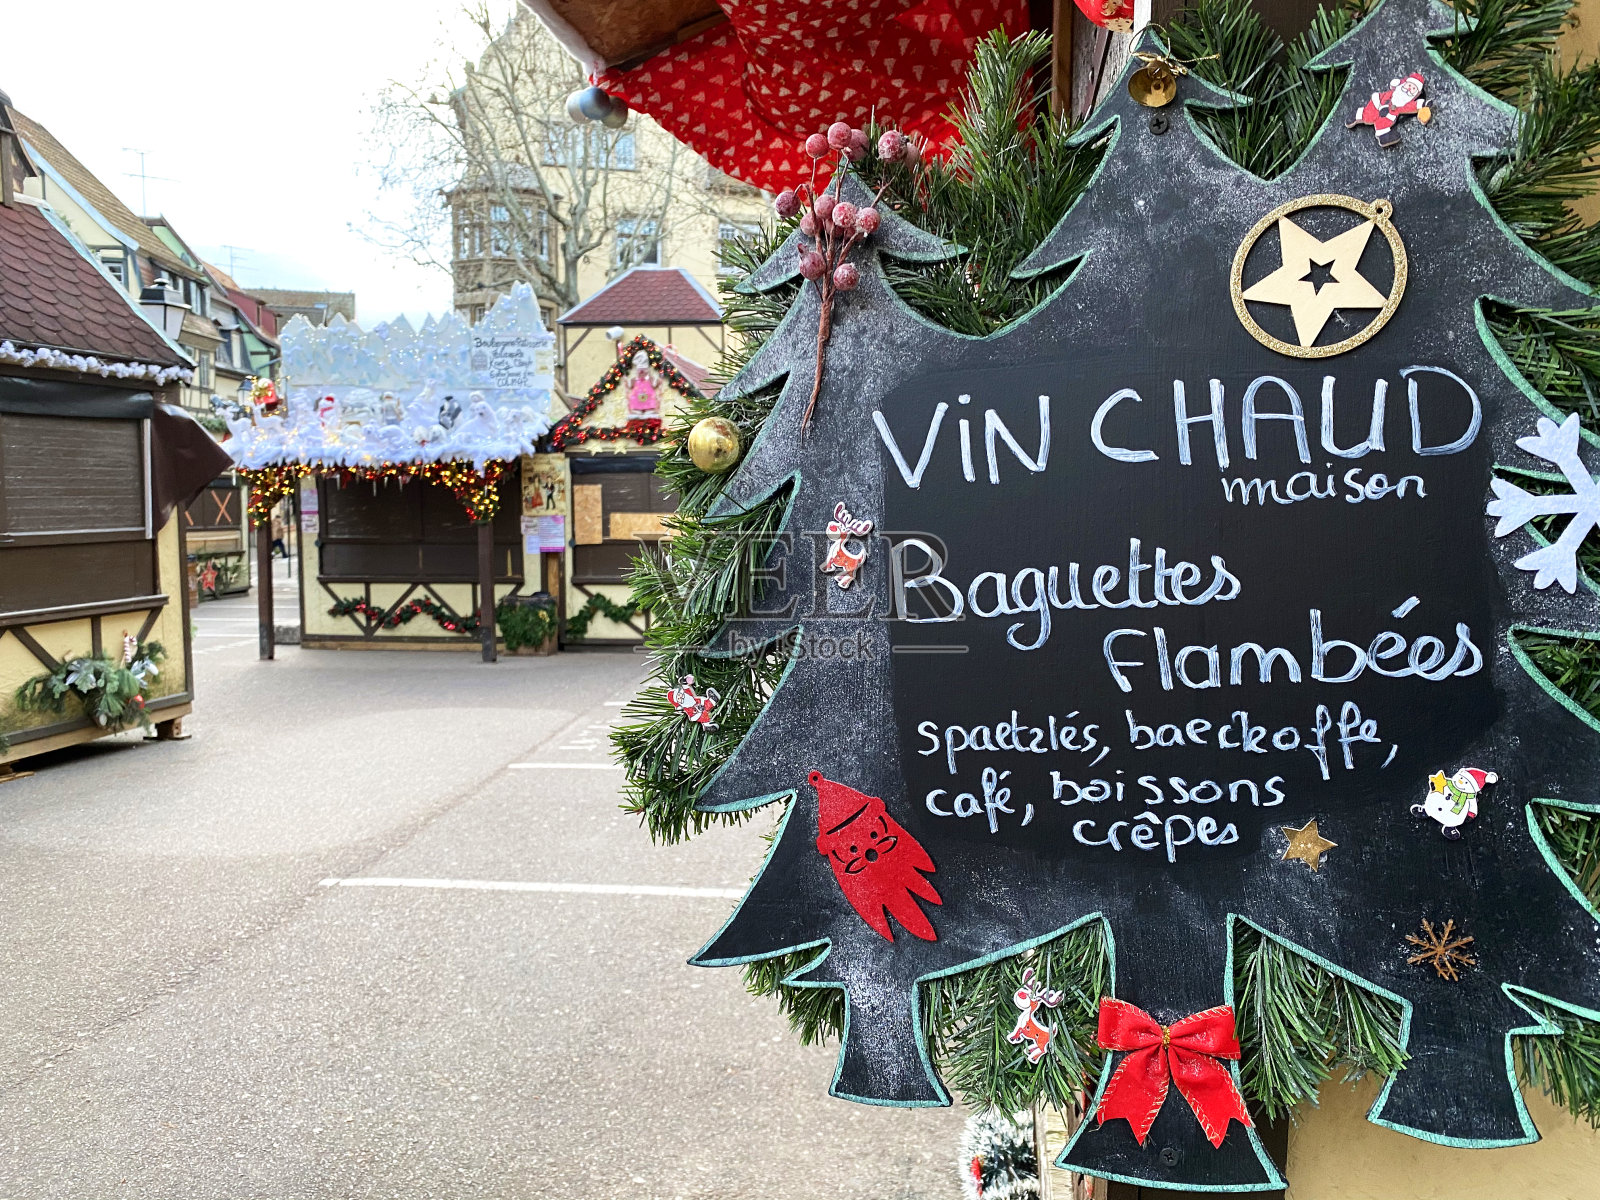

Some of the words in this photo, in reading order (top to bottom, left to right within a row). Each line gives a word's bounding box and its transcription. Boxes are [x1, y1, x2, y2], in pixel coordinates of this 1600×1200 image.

[1091, 365, 1483, 469] CHAUD
[1221, 461, 1427, 505] maison
[894, 537, 1241, 651] Baguettes
[1102, 596, 1484, 693] Flambées
[917, 710, 1110, 775] spaetzlés,
[926, 767, 1034, 833] café,
[1051, 770, 1285, 806] boissons
[1072, 812, 1240, 863] crêpes
